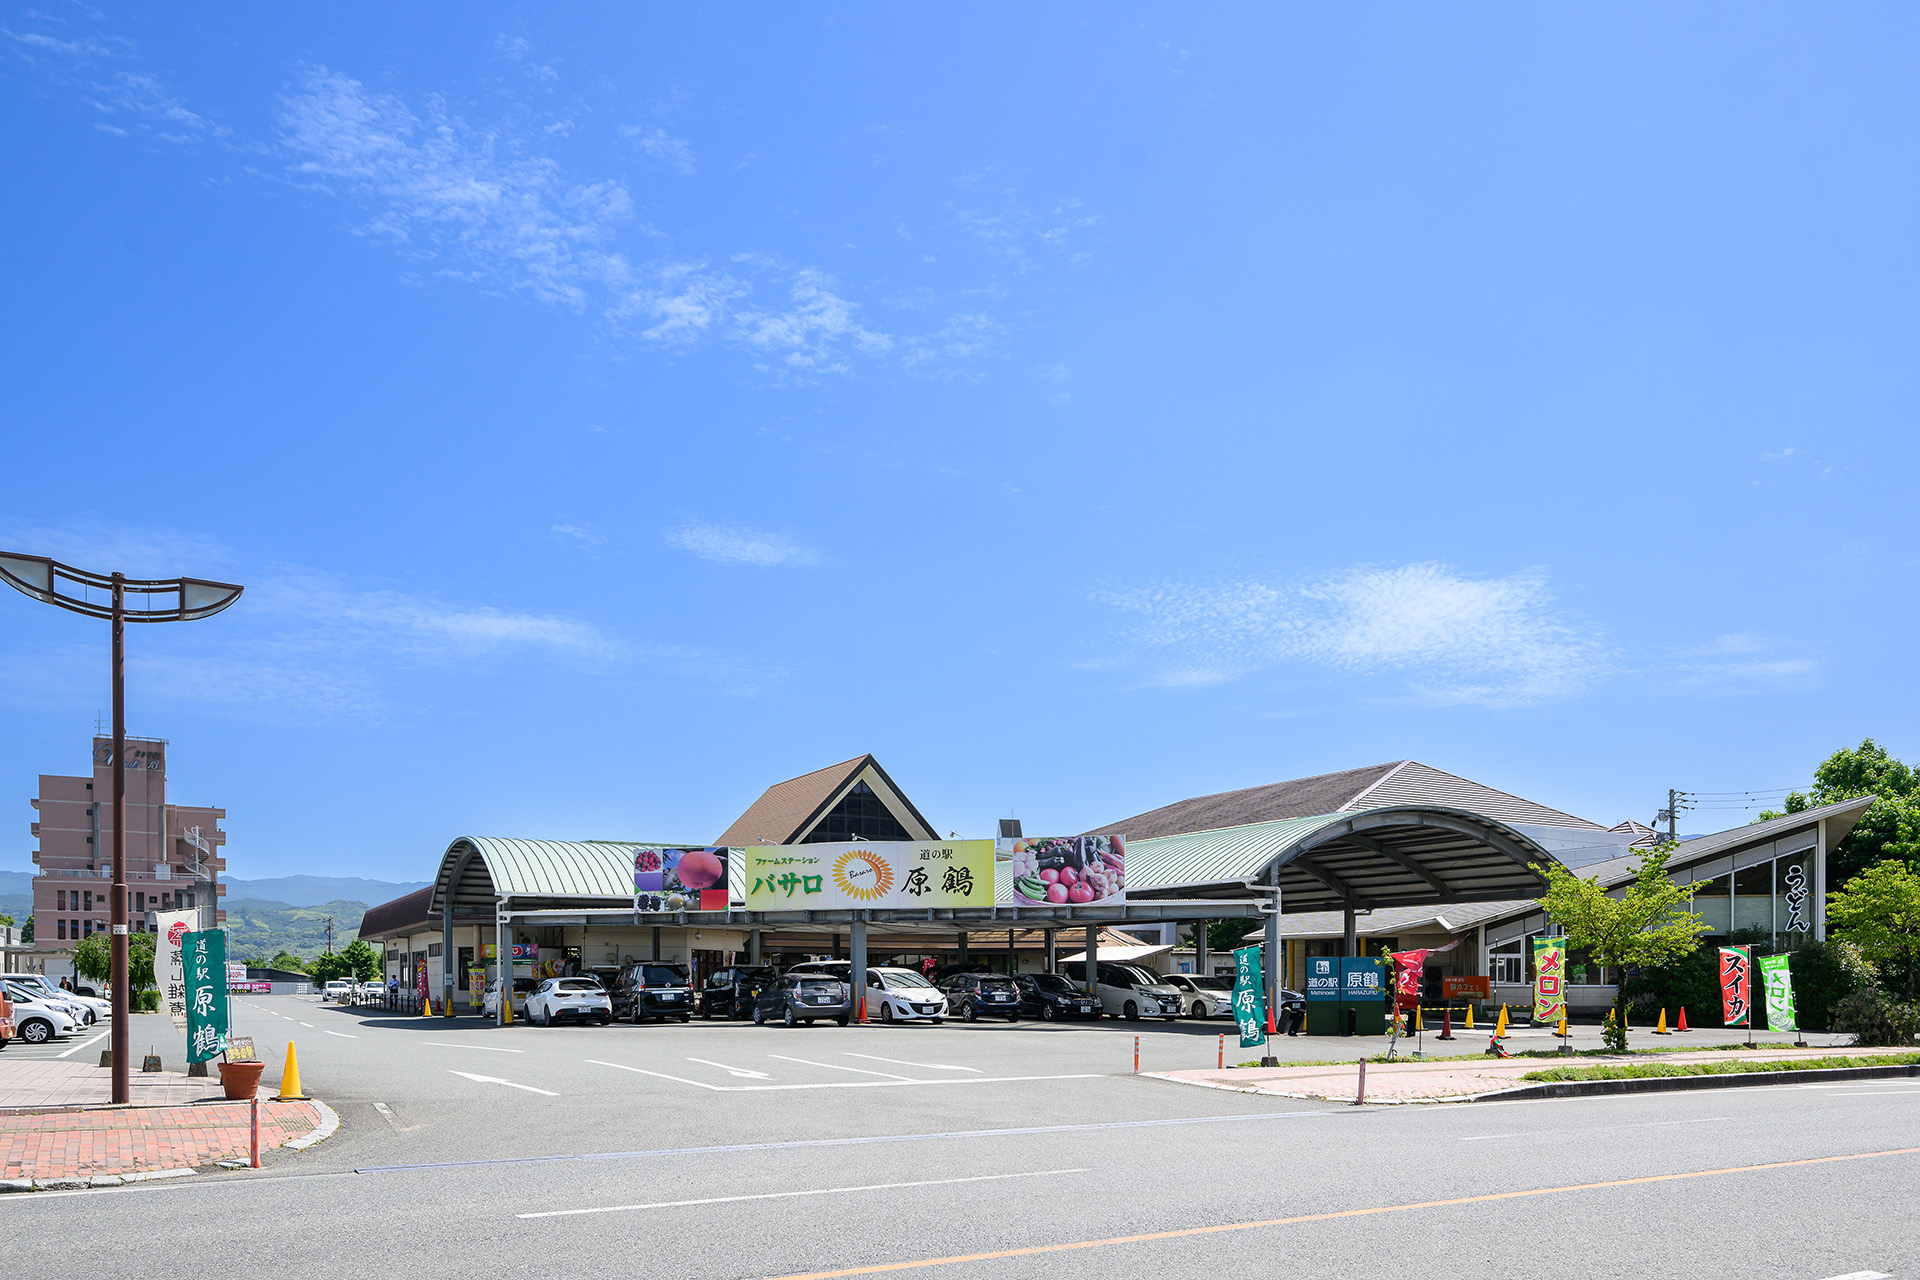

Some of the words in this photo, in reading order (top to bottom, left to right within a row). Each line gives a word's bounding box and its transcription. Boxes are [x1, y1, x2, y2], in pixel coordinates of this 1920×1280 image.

[755, 857, 820, 866] ファームステーション
[919, 849, 953, 860] 道の駅
[750, 872, 823, 898] バサロ
[901, 866, 974, 897] 原鶴
[1785, 865, 1810, 932] うどん
[194, 938, 211, 981] 道の駅
[1239, 953, 1252, 986] 道の駅
[1307, 977, 1339, 988] 道の駅
[1347, 972, 1379, 987] 原鶴
[1538, 950, 1561, 1020] メロン
[1722, 955, 1746, 1018] スイカ
[192, 985, 220, 1057] 原鶴
[1235, 989, 1260, 1042] 原鶴
